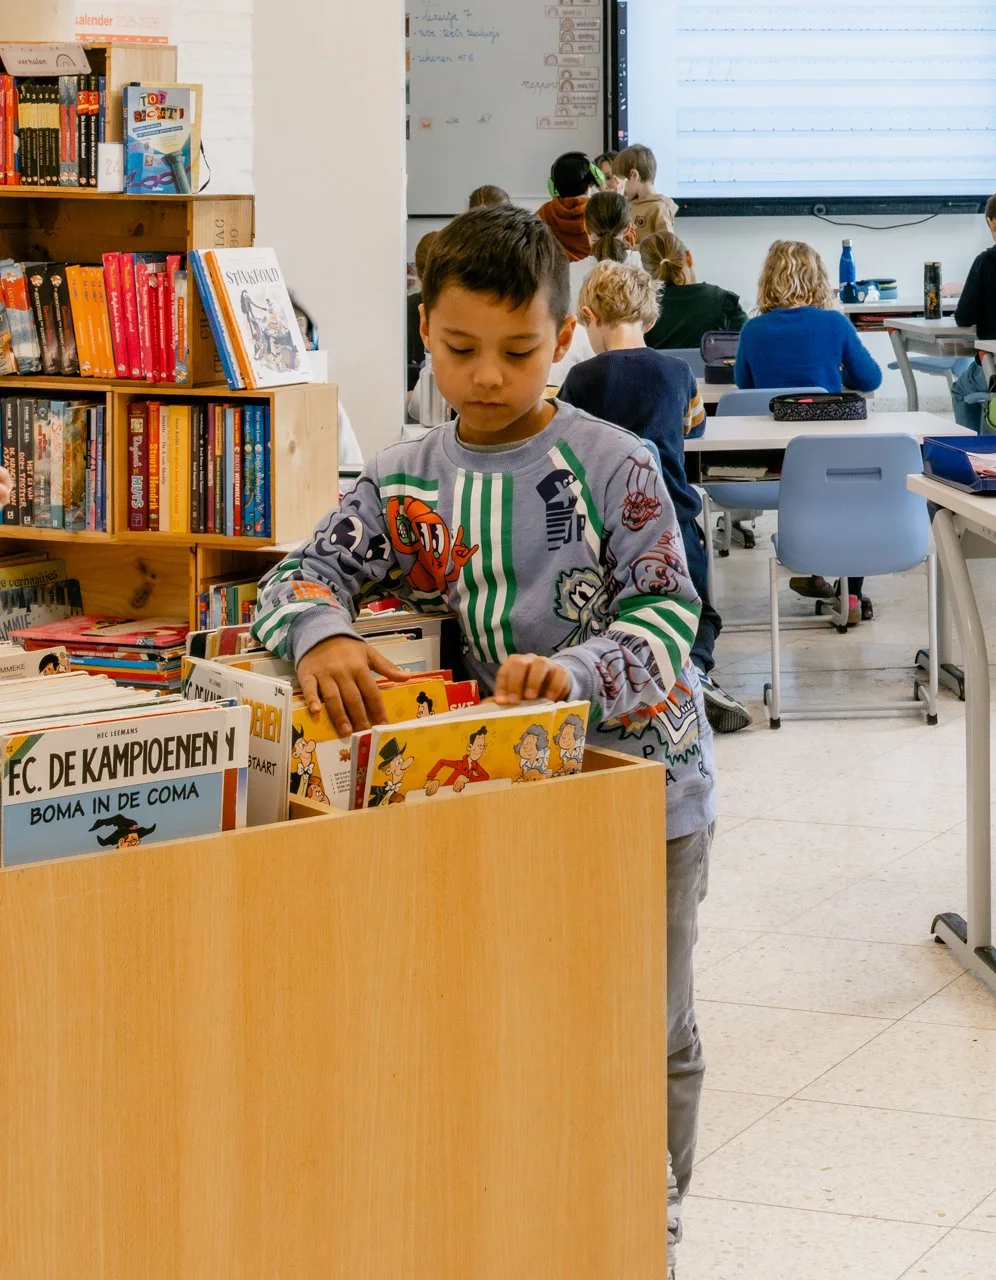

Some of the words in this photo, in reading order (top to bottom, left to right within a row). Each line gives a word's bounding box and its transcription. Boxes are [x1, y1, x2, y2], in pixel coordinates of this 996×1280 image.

[17, 54, 47, 65] verhalen
[140, 92, 167, 107] TOP
[129, 435, 142, 468] Dagboek
[149, 443, 158, 473] Stoute
[149, 476, 158, 509] Hendrik
[96, 732, 108, 740] HEC
[110, 727, 139, 738] LEEMANS
[8, 756, 42, 797] F.C.
[49, 750, 76, 790] DE
[82, 730, 219, 785] KAMPIOENEN
[30, 799, 85, 826] BOMA
[92, 794, 110, 815] IN
[118, 791, 140, 811] DE
[147, 781, 199, 806] COMA
